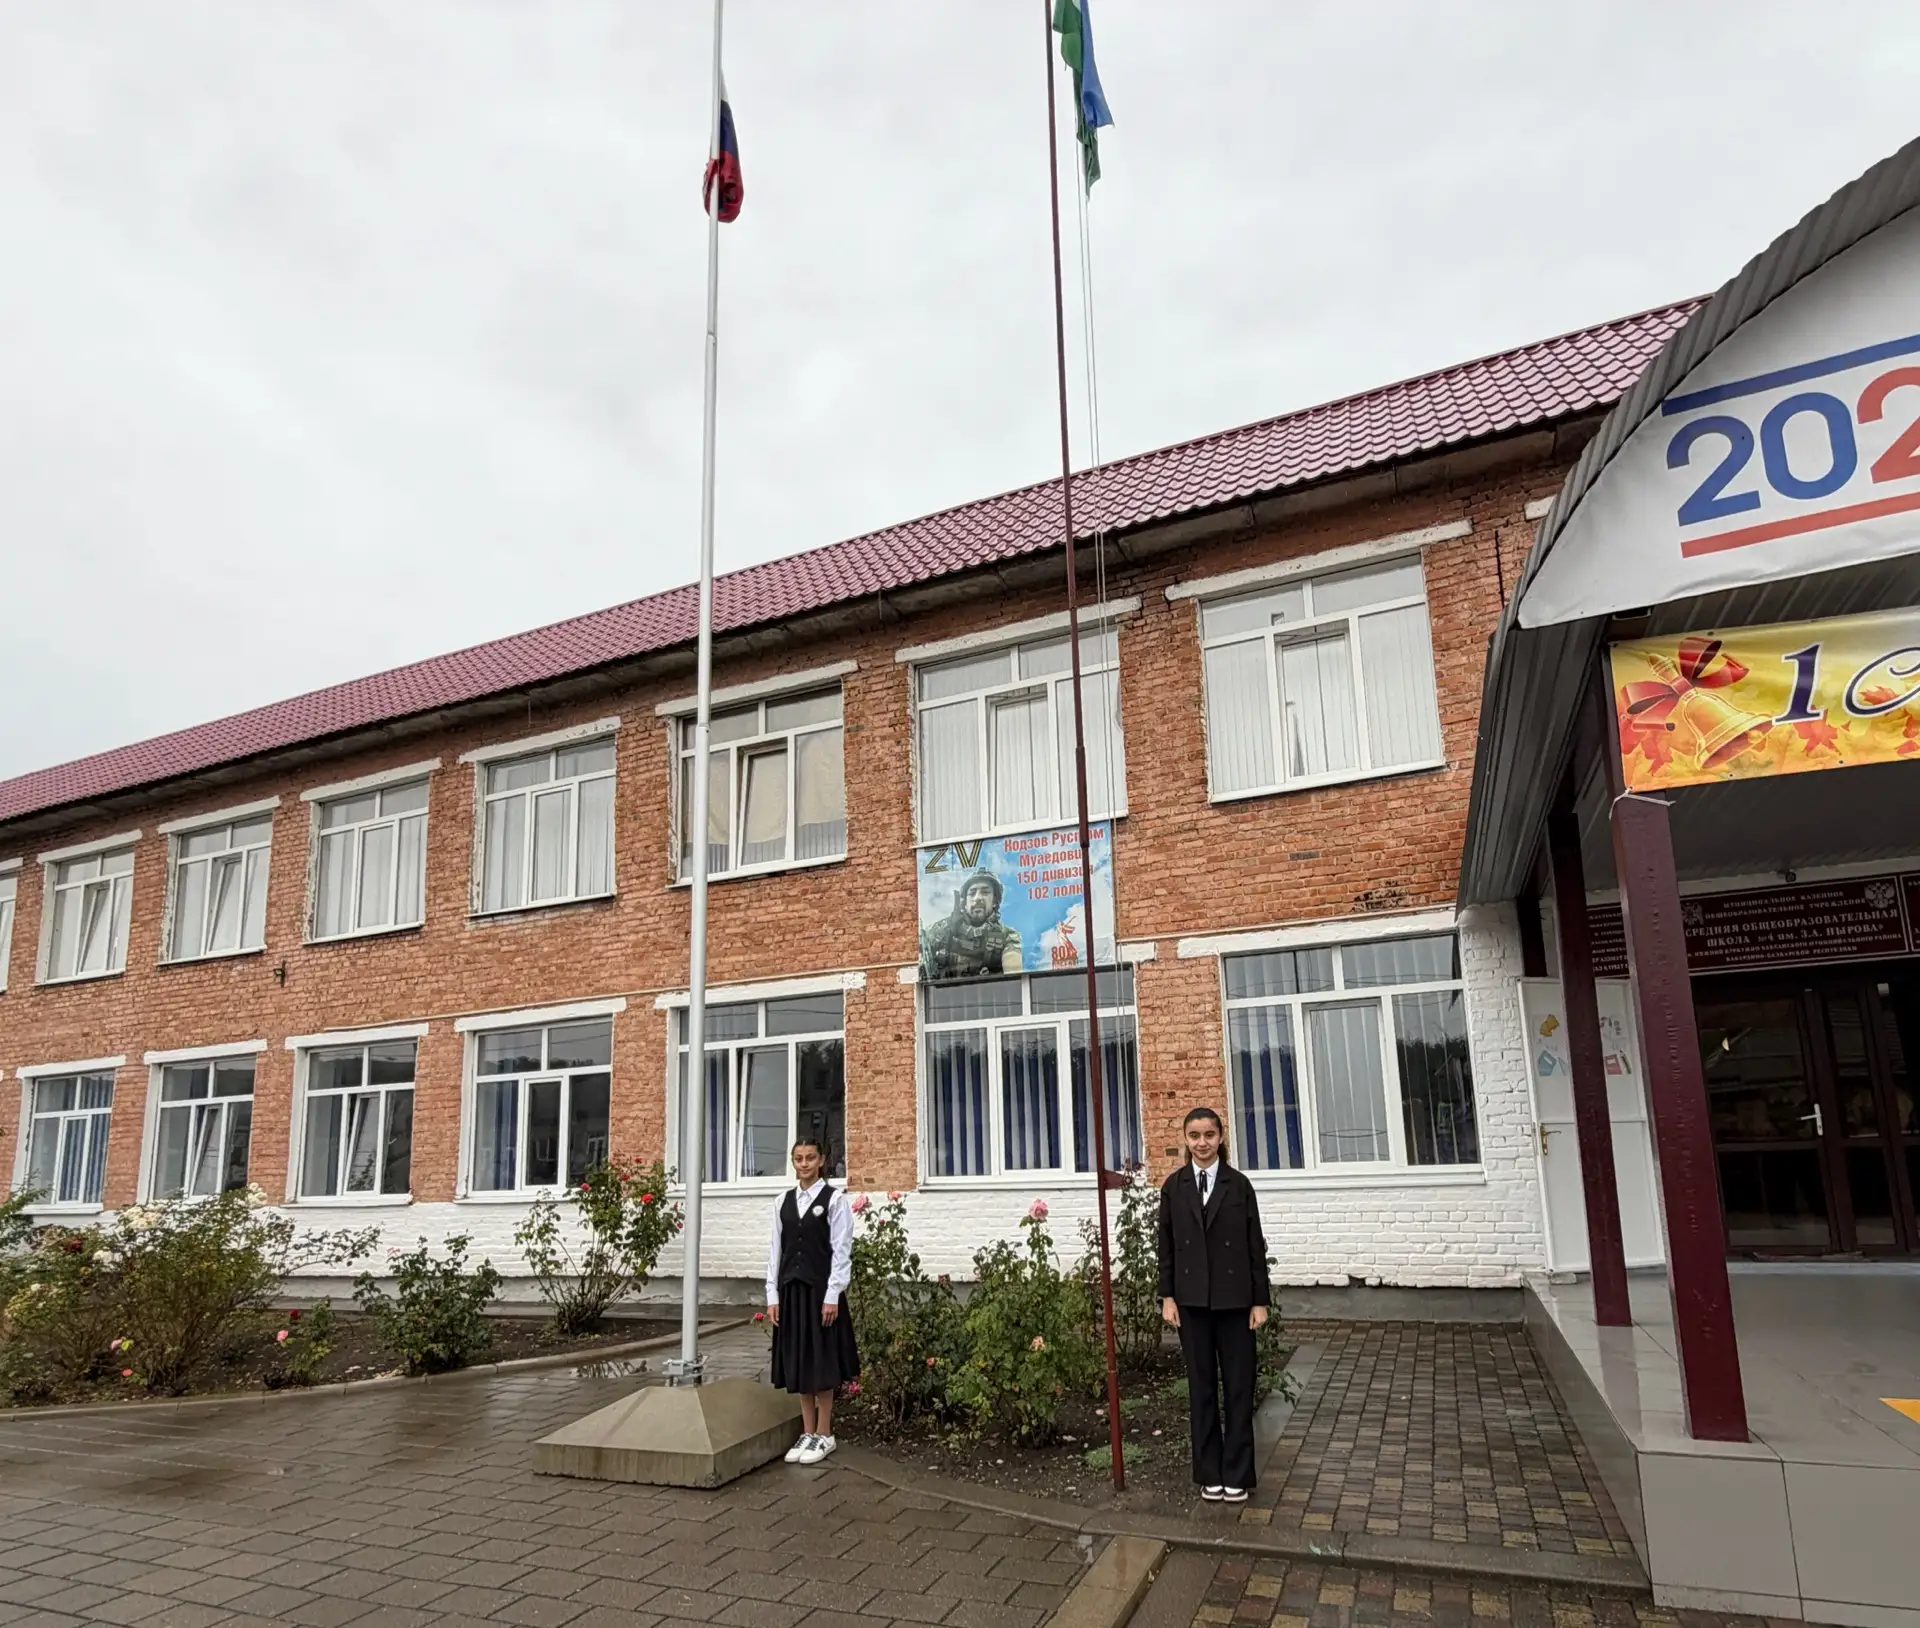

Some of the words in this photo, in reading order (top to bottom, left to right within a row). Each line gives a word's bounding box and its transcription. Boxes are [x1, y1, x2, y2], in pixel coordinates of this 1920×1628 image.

[1019, 848, 1082, 867] Муаедови
[1017, 870, 1038, 885] 150
[1028, 885, 1049, 901] 102
[1685, 923, 1739, 937] СРЕДНЯЯ
[1742, 909, 1898, 932] ОБЩЕОБРАЗОВАТЕЛЬНАЯ
[1706, 935, 1750, 947] ШКОЛА
